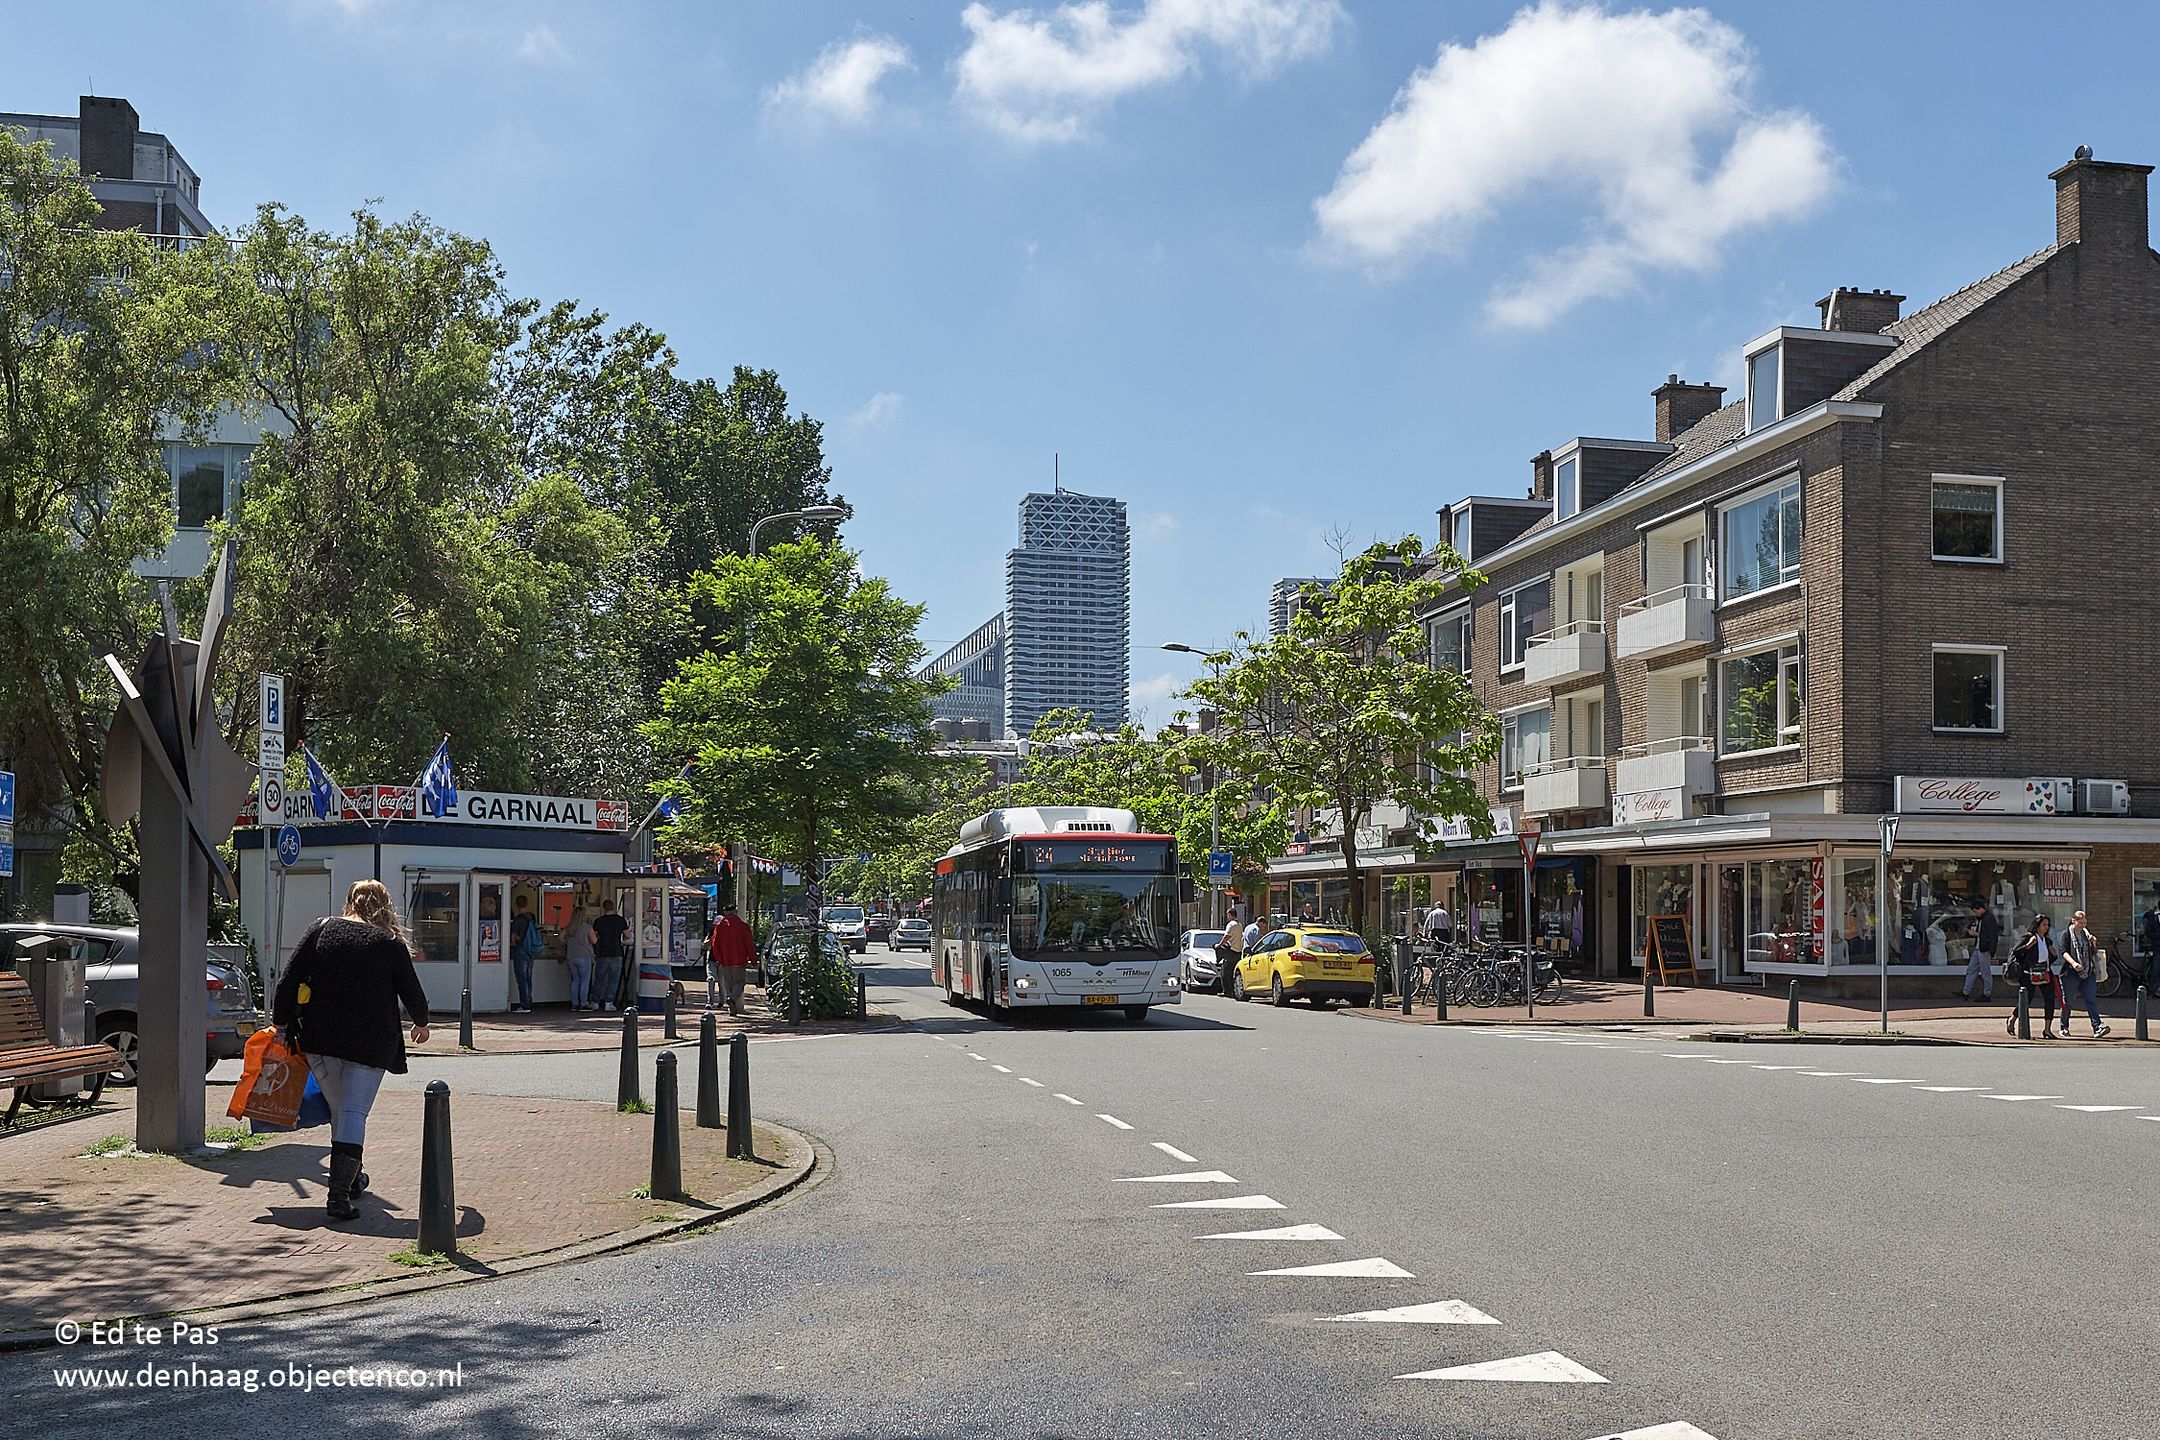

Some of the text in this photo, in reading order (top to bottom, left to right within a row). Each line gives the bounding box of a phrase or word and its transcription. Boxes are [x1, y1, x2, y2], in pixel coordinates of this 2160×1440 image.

[267, 789, 279, 802] 30
[285, 794, 339, 819] GARNAL
[1634, 792, 1672, 820] College
[1918, 779, 2001, 811] College
[467, 796, 593, 825] GARNAAL
[1812, 860, 1824, 954] SALE
[1052, 968, 1072, 977] 1065
